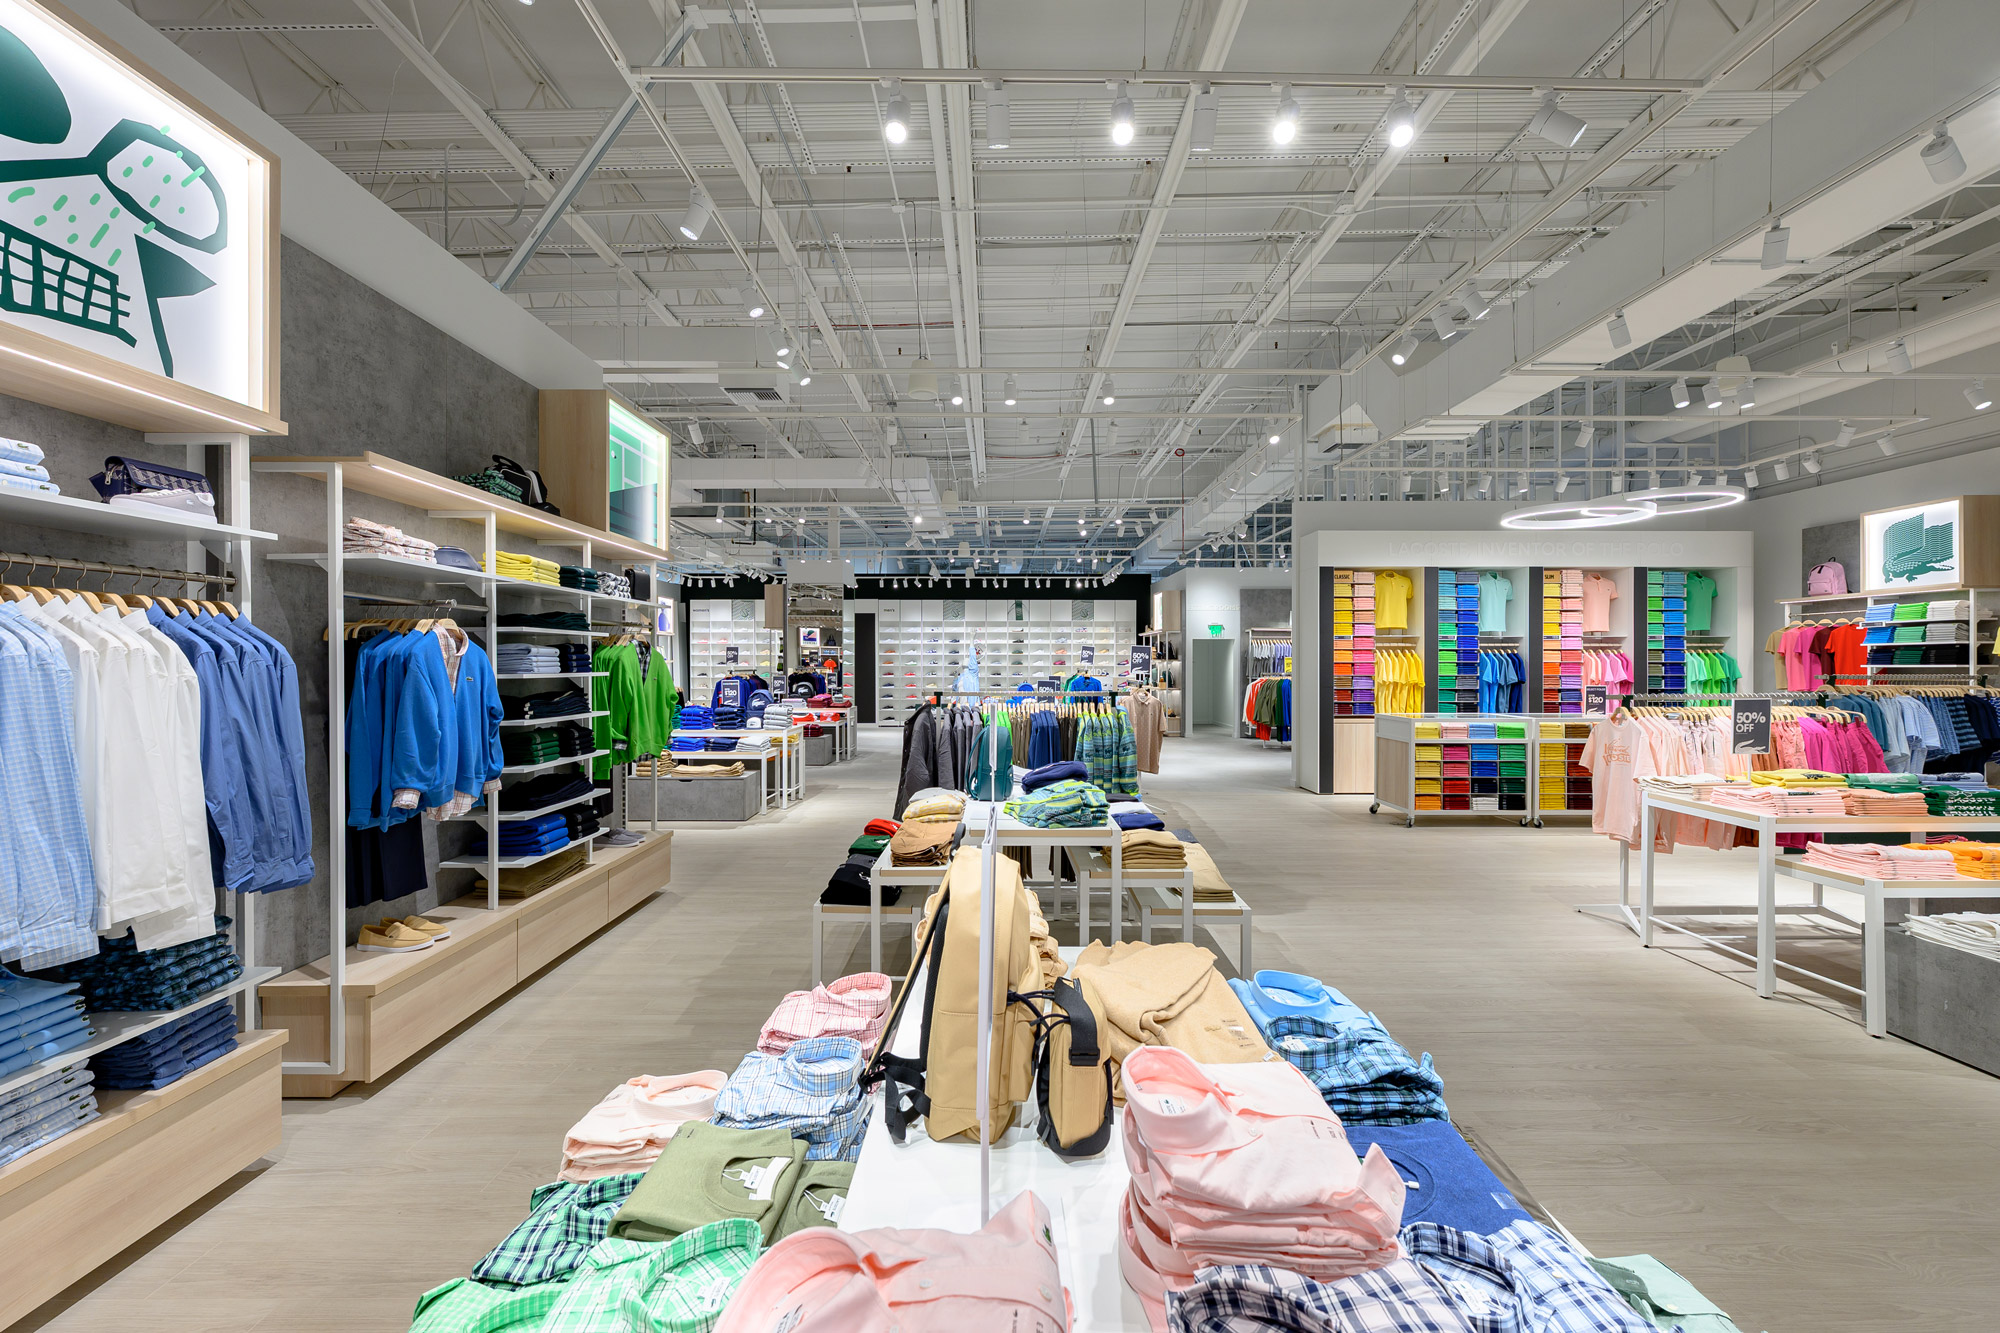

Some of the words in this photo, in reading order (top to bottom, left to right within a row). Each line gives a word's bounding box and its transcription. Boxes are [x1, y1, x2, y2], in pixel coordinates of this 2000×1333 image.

[1477, 542, 1567, 556] INVENTOR
[1571, 542, 1595, 556] OF
[1599, 542, 1631, 556] THE
[1636, 542, 1684, 556] POLO
[1132, 652, 1150, 660] 50%
[1588, 696, 1604, 704] $120
[1736, 711, 1767, 724] 50%
[1735, 723, 1755, 733] OFF
